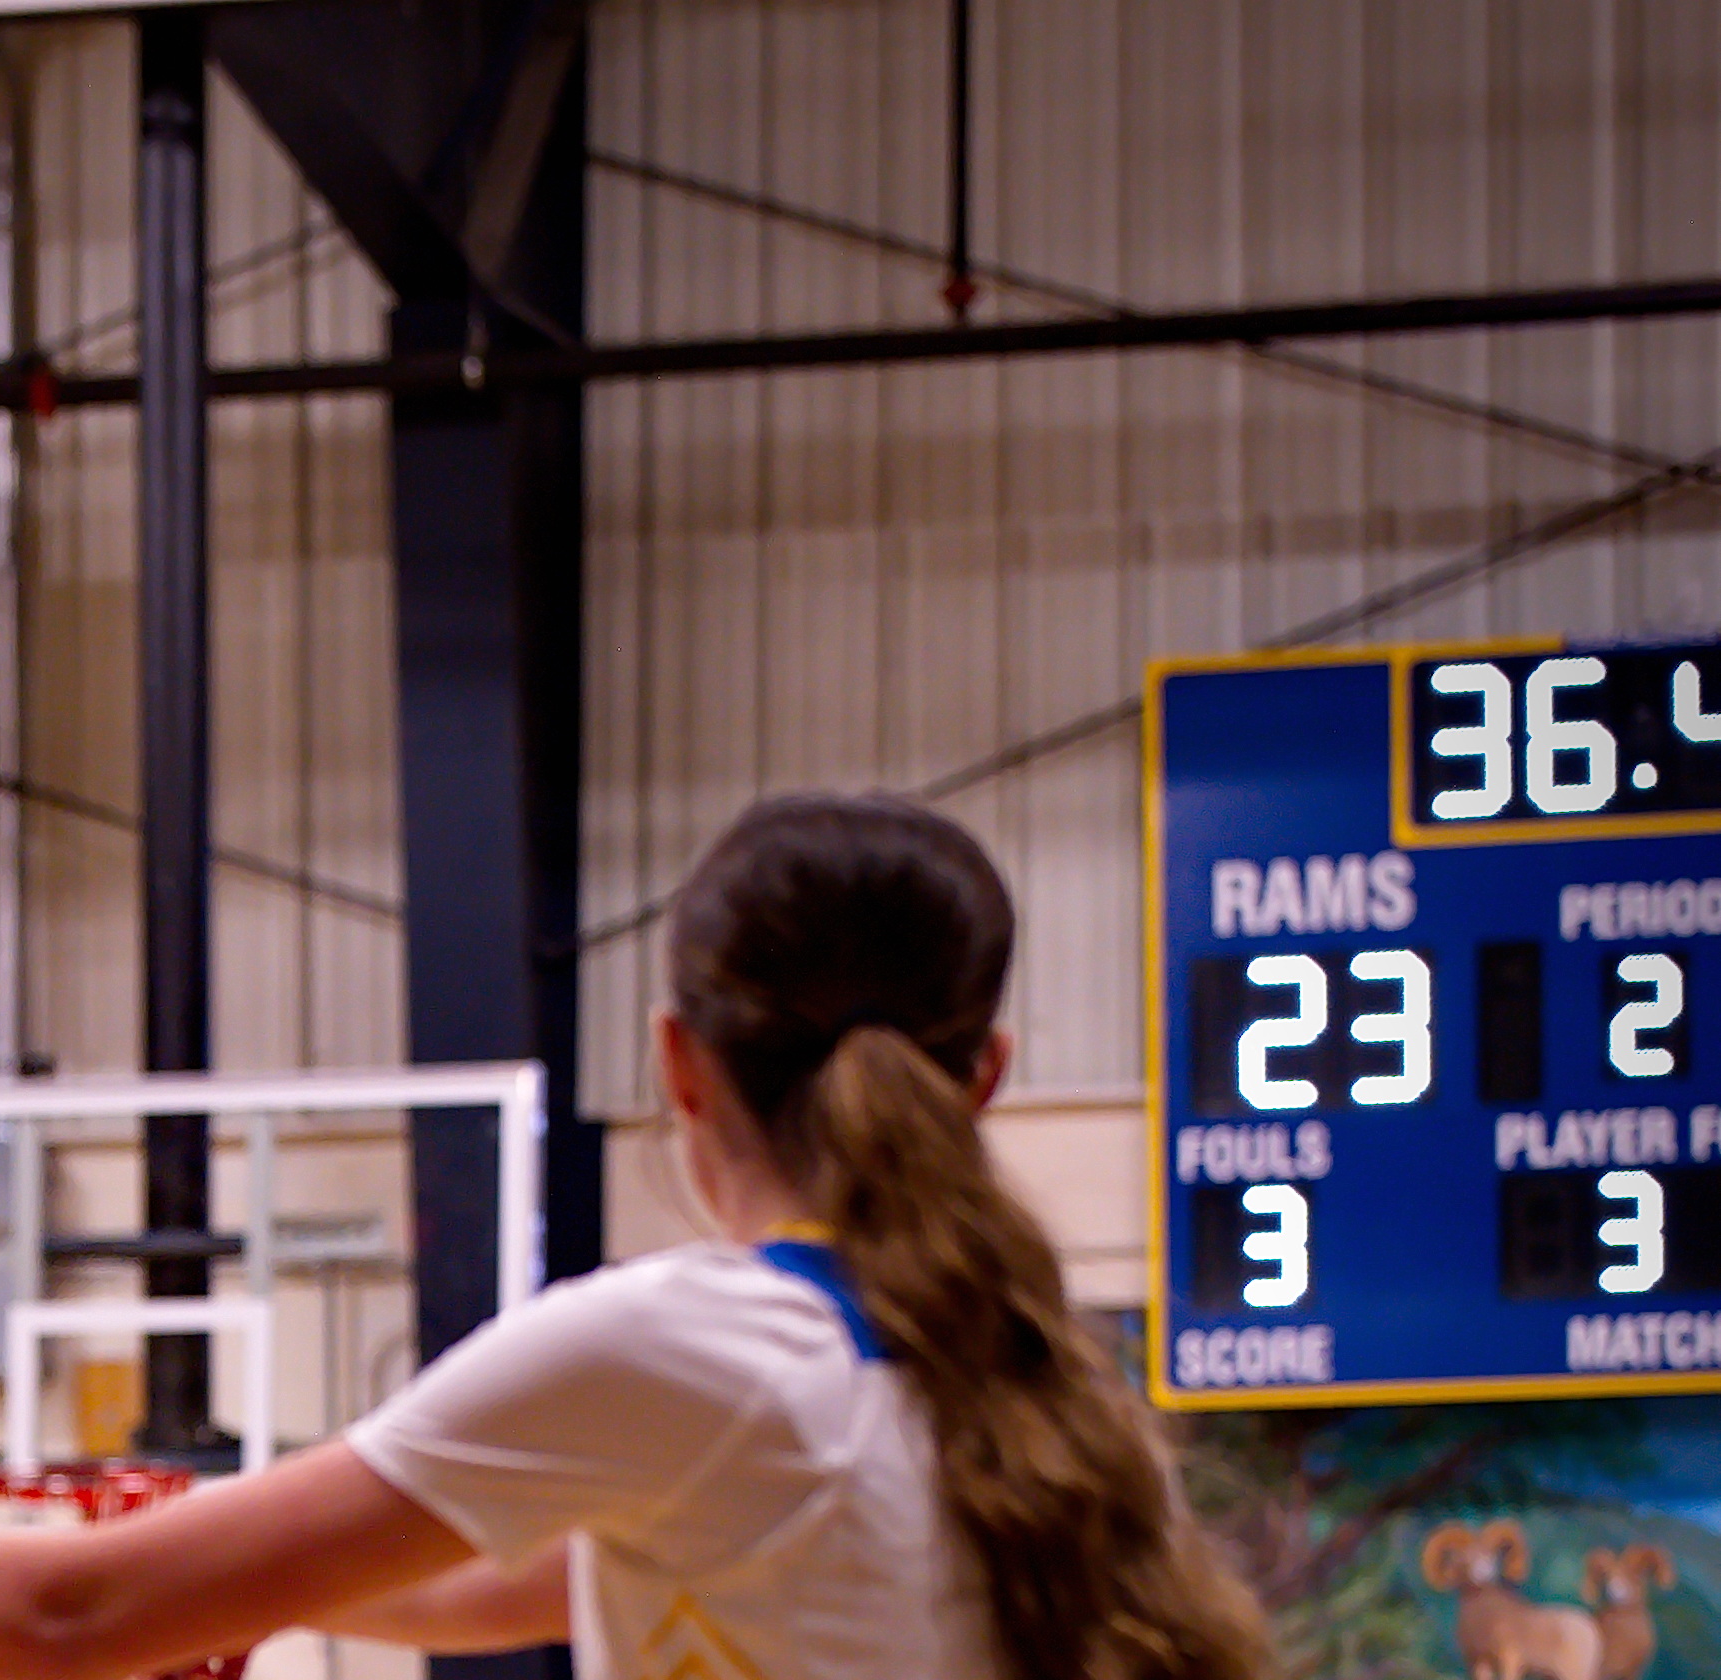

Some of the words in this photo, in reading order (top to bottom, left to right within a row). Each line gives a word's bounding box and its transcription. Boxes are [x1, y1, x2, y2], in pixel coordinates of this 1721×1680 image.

[1211, 849, 1418, 938] RAMS
[1237, 949, 1432, 1110] 23
[1609, 953, 1684, 1078] 2
[1178, 1121, 1333, 1184] FOULS
[1495, 1106, 1678, 1171] PLAYER
[1242, 1184, 1309, 1307] 3
[1598, 1170, 1665, 1293] 3
[1176, 1325, 1337, 1385] SCORE
